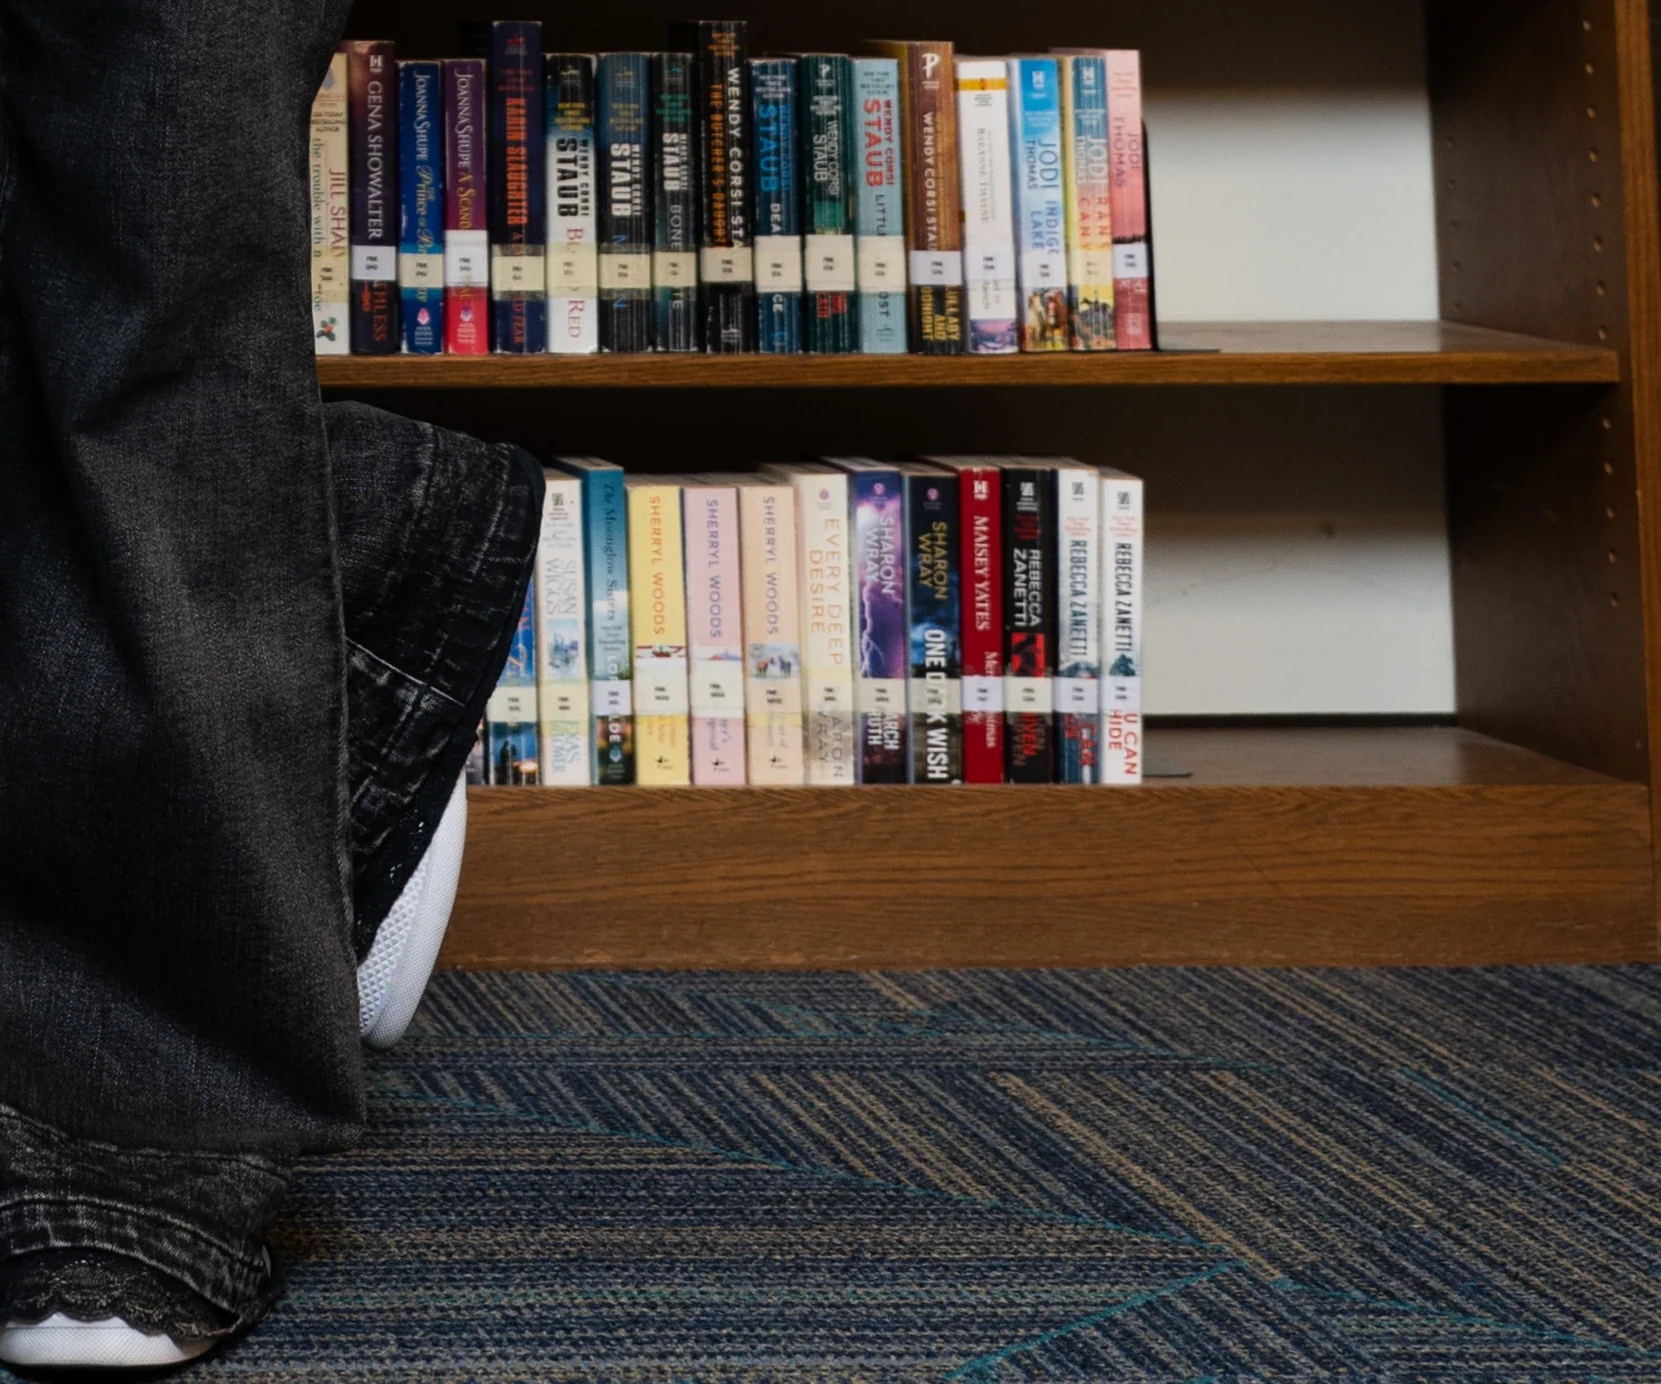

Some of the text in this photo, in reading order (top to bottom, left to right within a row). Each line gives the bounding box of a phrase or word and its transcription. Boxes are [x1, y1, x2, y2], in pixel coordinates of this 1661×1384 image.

[367, 80, 383, 239] GENA SHOWALTER
[506, 98, 528, 225] KARIN SLAUGHTER
[863, 99, 884, 187] STAUB
[883, 99, 894, 186] WENDY CORSI
[1025, 138, 1037, 190] THOMAS
[1039, 137, 1060, 189] JODI
[1030, 211, 1041, 249] LAKE
[545, 558, 561, 615] WIGGS
[561, 559, 576, 615] SUSAN
[603, 483, 618, 621] The Moonglow Sisters
[650, 496, 664, 636] SHERRYL WOODS
[918, 533, 932, 587] WRAY
[934, 521, 947, 599] SHARON
[974, 515, 990, 631] MAISEY YATES
[1115, 542, 1131, 652] REBECCA ZANETTI
[925, 629, 944, 667] ONE
[927, 728, 947, 779] WISH
